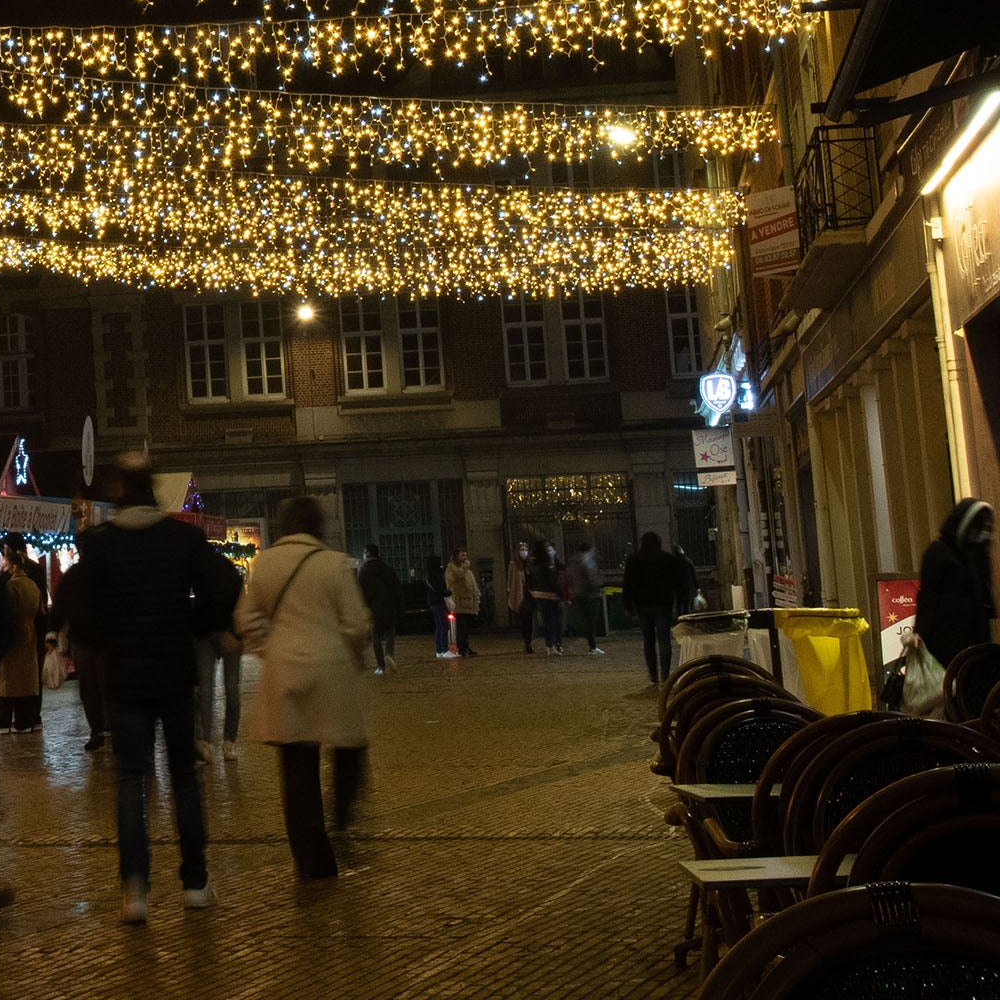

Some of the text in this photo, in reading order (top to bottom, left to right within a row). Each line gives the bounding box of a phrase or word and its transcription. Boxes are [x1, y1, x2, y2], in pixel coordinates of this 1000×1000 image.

[751, 216, 795, 241] A VENDRE
[896, 625, 914, 636] JO
